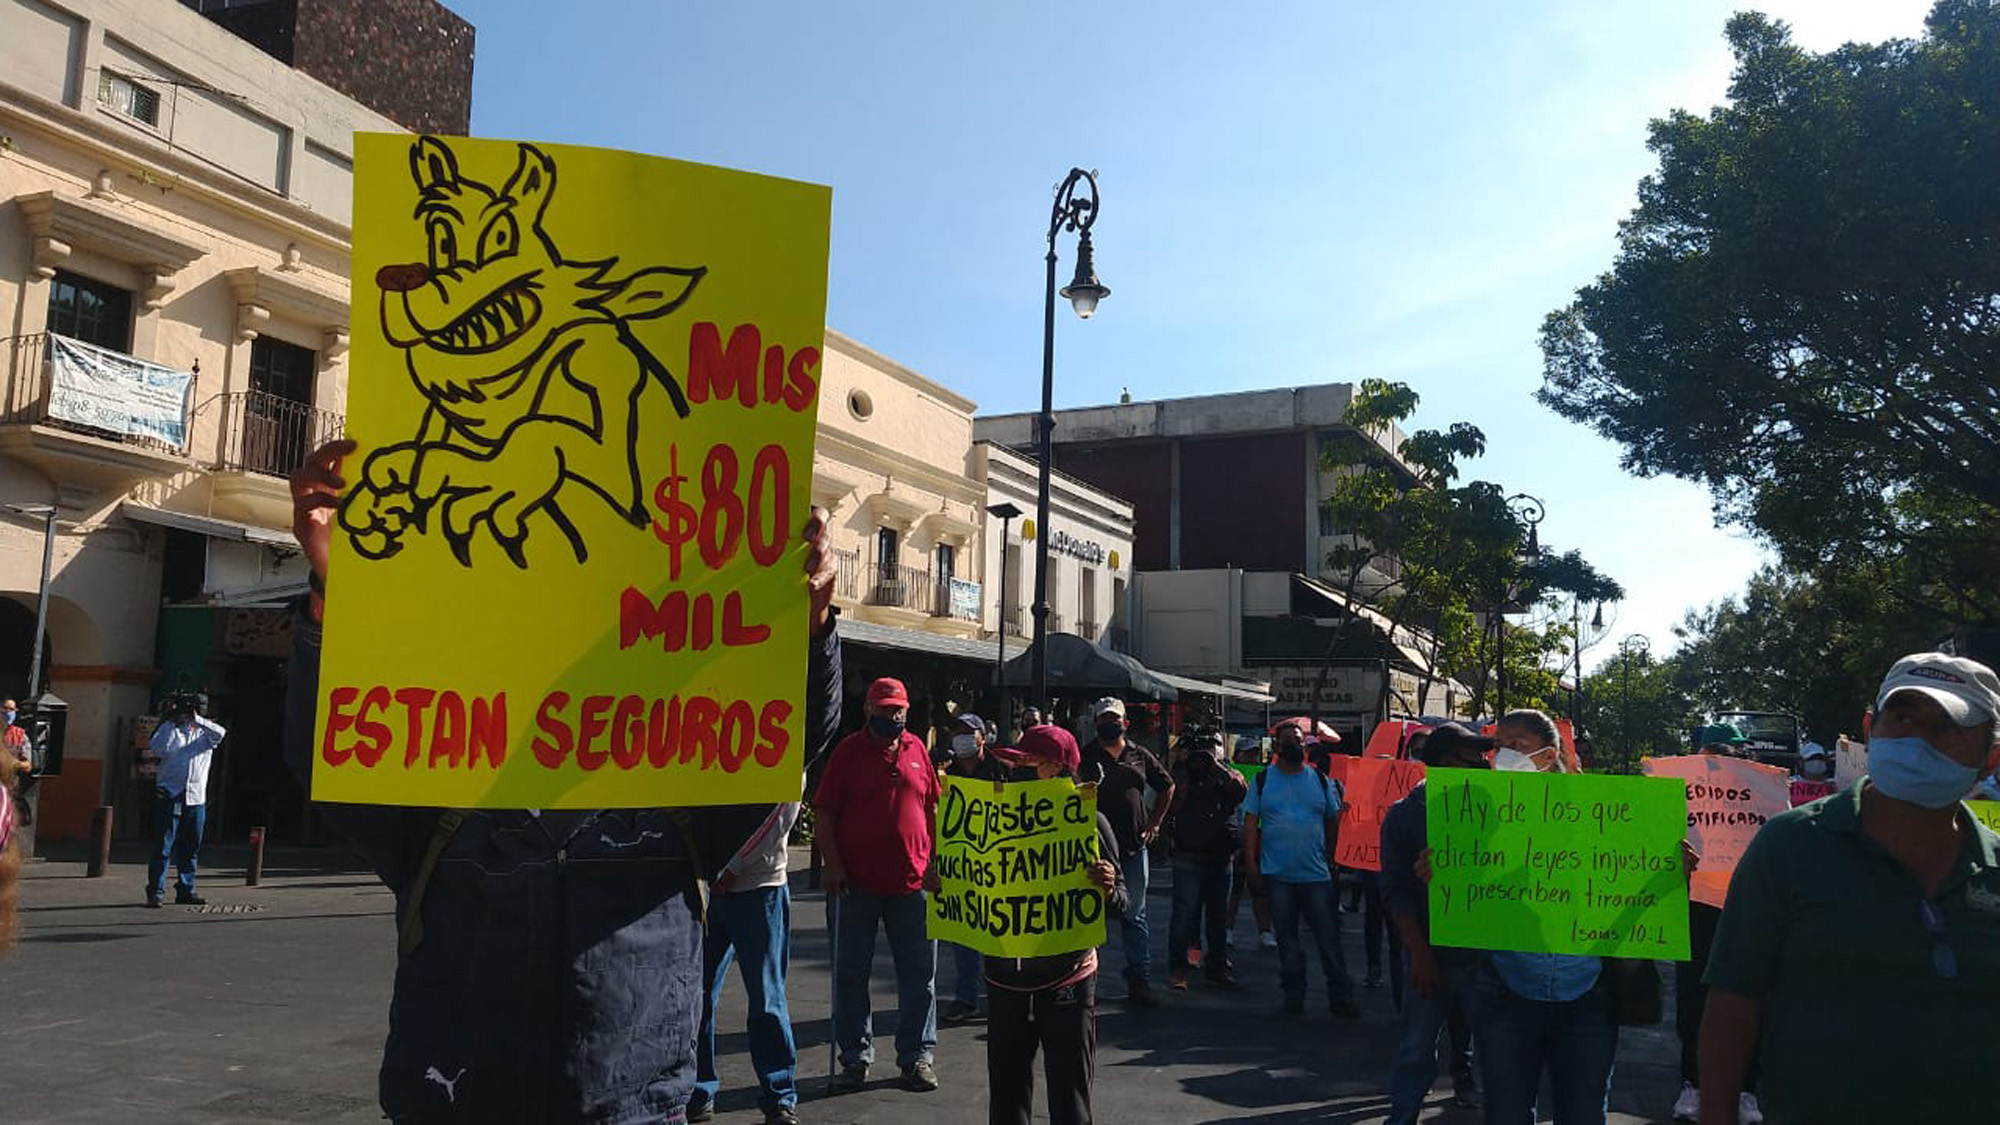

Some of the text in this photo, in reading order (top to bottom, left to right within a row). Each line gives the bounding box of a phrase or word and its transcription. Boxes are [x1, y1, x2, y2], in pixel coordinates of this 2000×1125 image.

[653, 442, 790, 581] $80
[620, 585, 771, 652] MIL
[322, 686, 794, 774] ESTAN SEGUROS
[1063, 794, 1090, 825] a
[1497, 779, 1527, 825] de
[1543, 782, 1581, 824] los
[1592, 801, 1633, 835] que
[1685, 784, 1751, 801] EDIDOS
[1435, 832, 1506, 870] dictan
[1525, 836, 1582, 879] leyes
[1592, 844, 1677, 883] injustas
[965, 888, 1103, 938] SUSTENTO
[1441, 884, 1452, 914] y
[1467, 879, 1571, 913] prescriben
